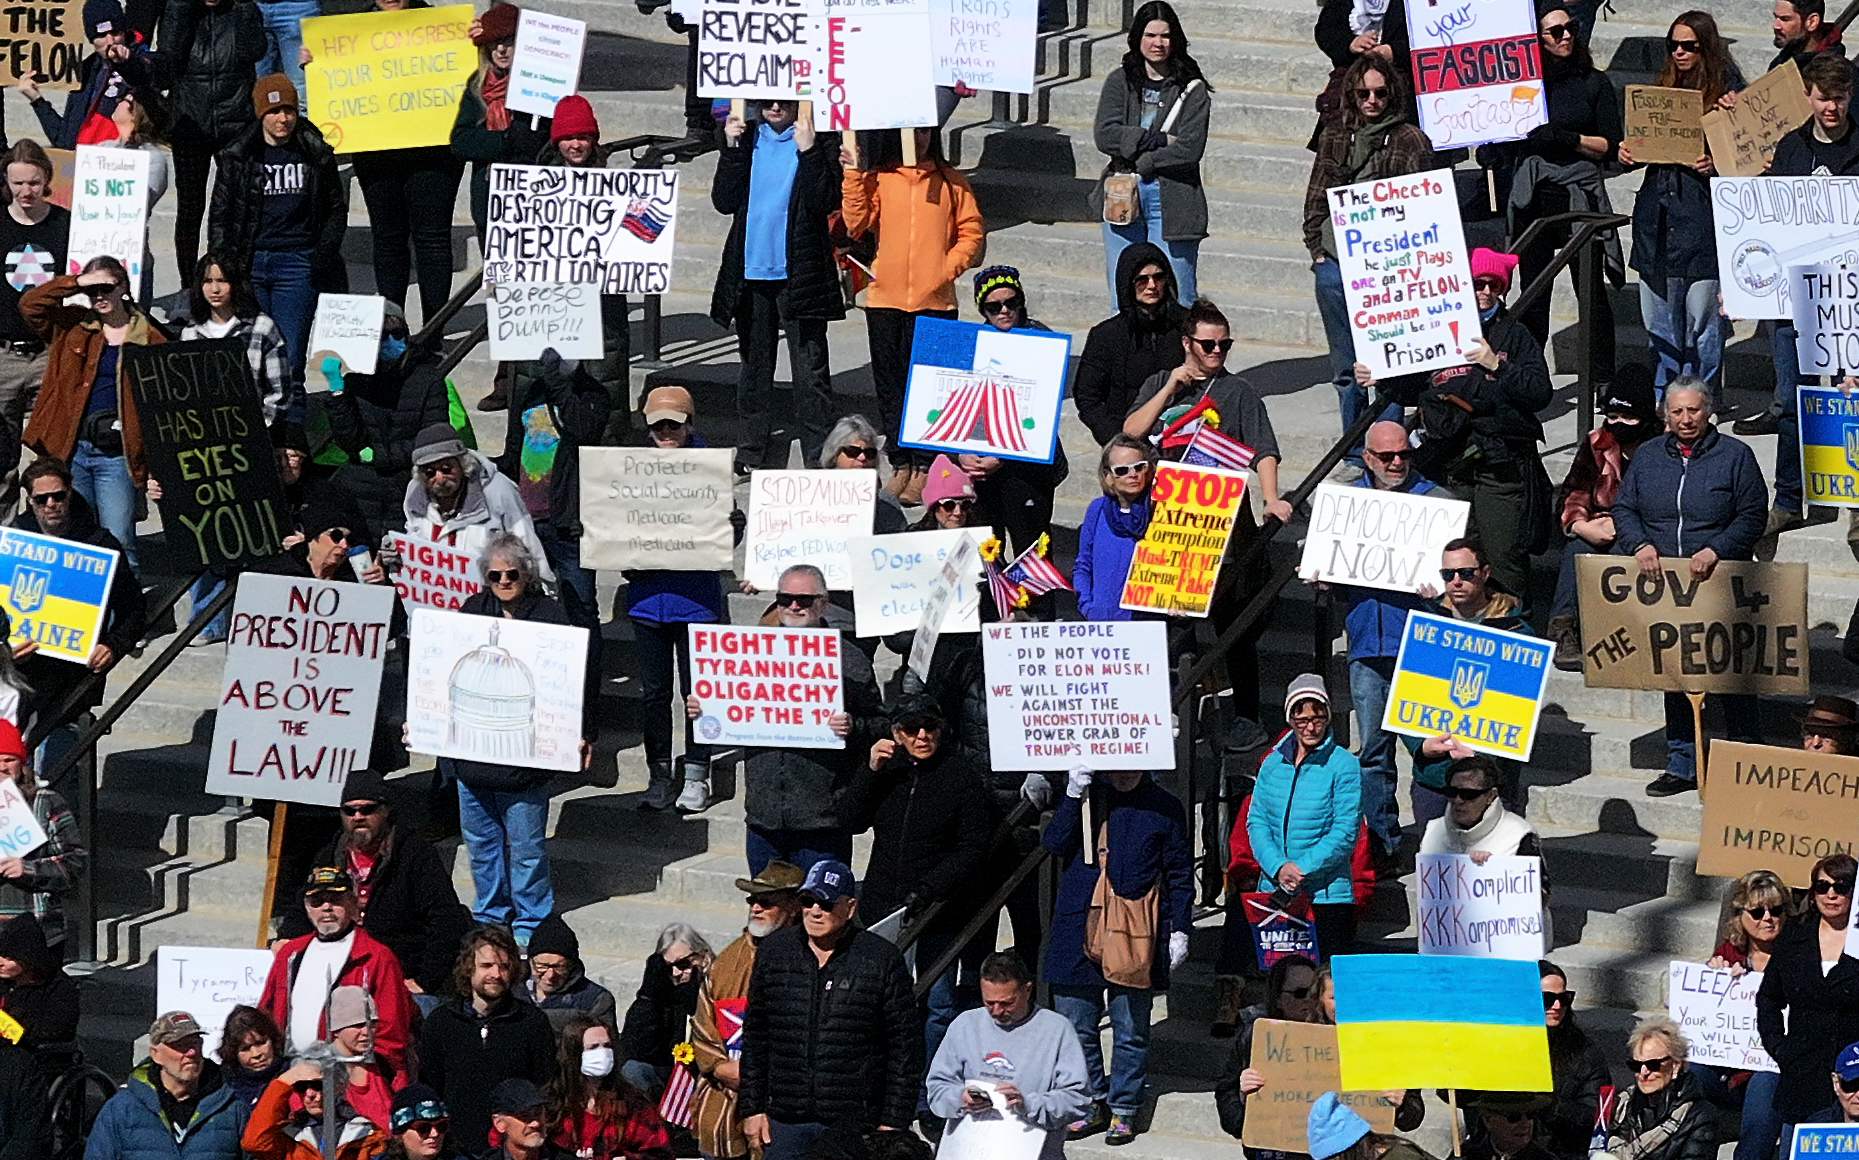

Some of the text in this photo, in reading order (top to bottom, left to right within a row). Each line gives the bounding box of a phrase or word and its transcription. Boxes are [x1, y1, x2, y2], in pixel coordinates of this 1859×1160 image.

[3, 6, 65, 37] THE
[702, 10, 808, 44] REVERSE
[1425, 3, 1475, 47] your
[322, 34, 358, 58] HEY
[955, 38, 988, 53] ARE
[322, 52, 458, 91] YOUR SILENCE
[700, 51, 792, 87] RECLAIM
[827, 17, 851, 130] FELON
[1417, 38, 1538, 92] FASCIST
[328, 94, 379, 120] GIVES
[1742, 88, 1770, 120] YOU
[81, 154, 135, 171] A President
[85, 178, 135, 197] IS NOT
[493, 168, 679, 205] THE only MINORITY
[1333, 178, 1443, 207] The Cheeto
[490, 193, 617, 236] DESTROYING
[1334, 204, 1406, 226] is not my
[484, 225, 603, 262] AMERICA
[1345, 223, 1439, 257] President
[1365, 259, 1379, 270] he
[1383, 252, 1412, 271] just
[1352, 274, 1397, 290] one on
[1363, 275, 1460, 308] and a FELON
[1803, 264, 1858, 300] THIS
[1354, 298, 1462, 329] Conman who
[1368, 318, 1440, 342] Should be in
[134, 350, 250, 402] HISTORY
[1804, 396, 1824, 414] WE
[155, 406, 249, 442] HAS ITS
[177, 444, 249, 481] EYES
[195, 479, 235, 505] ON
[609, 481, 718, 509] Social Security
[761, 476, 811, 506] STOP
[1152, 467, 1245, 508] STOP
[178, 499, 283, 564] YOU!
[627, 509, 693, 526] Medicare
[755, 509, 857, 540] Illegal Takeover
[1316, 493, 1465, 549] DEMOCRACY
[0, 538, 108, 576] STAND WITH
[394, 539, 471, 575] FIGHT
[754, 538, 823, 564] Restore FED
[871, 547, 922, 572] Doge
[1327, 540, 1426, 586] NOW
[1128, 563, 1214, 595] Extreme Fake
[1601, 566, 1769, 613] GOV 4
[288, 585, 340, 617] NO
[1122, 584, 1154, 606] NOT
[230, 613, 386, 659] PRESIDENT
[695, 631, 838, 657] FIGHT THE
[988, 625, 1114, 639] WE THE PEOPLE
[1414, 623, 1544, 668] WE STAND WITH
[1017, 647, 1130, 660] DID NOT VOTE
[1587, 622, 1799, 677] THE PEOPLE
[293, 657, 320, 680] IS
[695, 658, 838, 679] TYRANNICAL
[1019, 663, 1150, 677] FOR ELON MUSK!
[222, 679, 354, 716] ABOVE
[695, 680, 838, 703] OLIGARCHY
[992, 682, 1109, 696] WE WILL FIGHT
[727, 705, 803, 725] OF THE
[1022, 698, 1119, 711] AGAINST THE
[1022, 713, 1162, 726] UNCONSTITUTIONAL
[278, 720, 309, 737] THE
[1025, 727, 1147, 741] POWER GRAB OF
[1399, 699, 1523, 748] UKRAINE
[1026, 742, 1149, 756] TRUMP'S REGIME!
[1735, 761, 1859, 799] IMPEACH
[1779, 807, 1808, 821] AND
[1724, 826, 1853, 858] IMPRISON
[1420, 859, 1536, 905] KKKomplicit
[1260, 929, 1311, 942] UNITE
[172, 958, 238, 994] Tyranny
[1679, 1006, 1707, 1027] YOUR
[1266, 1031, 1334, 1062] WE THE
[1702, 1032, 1740, 1045] WILL
[1274, 1091, 1315, 1103] MORE
[1800, 1134, 1822, 1153] WE
